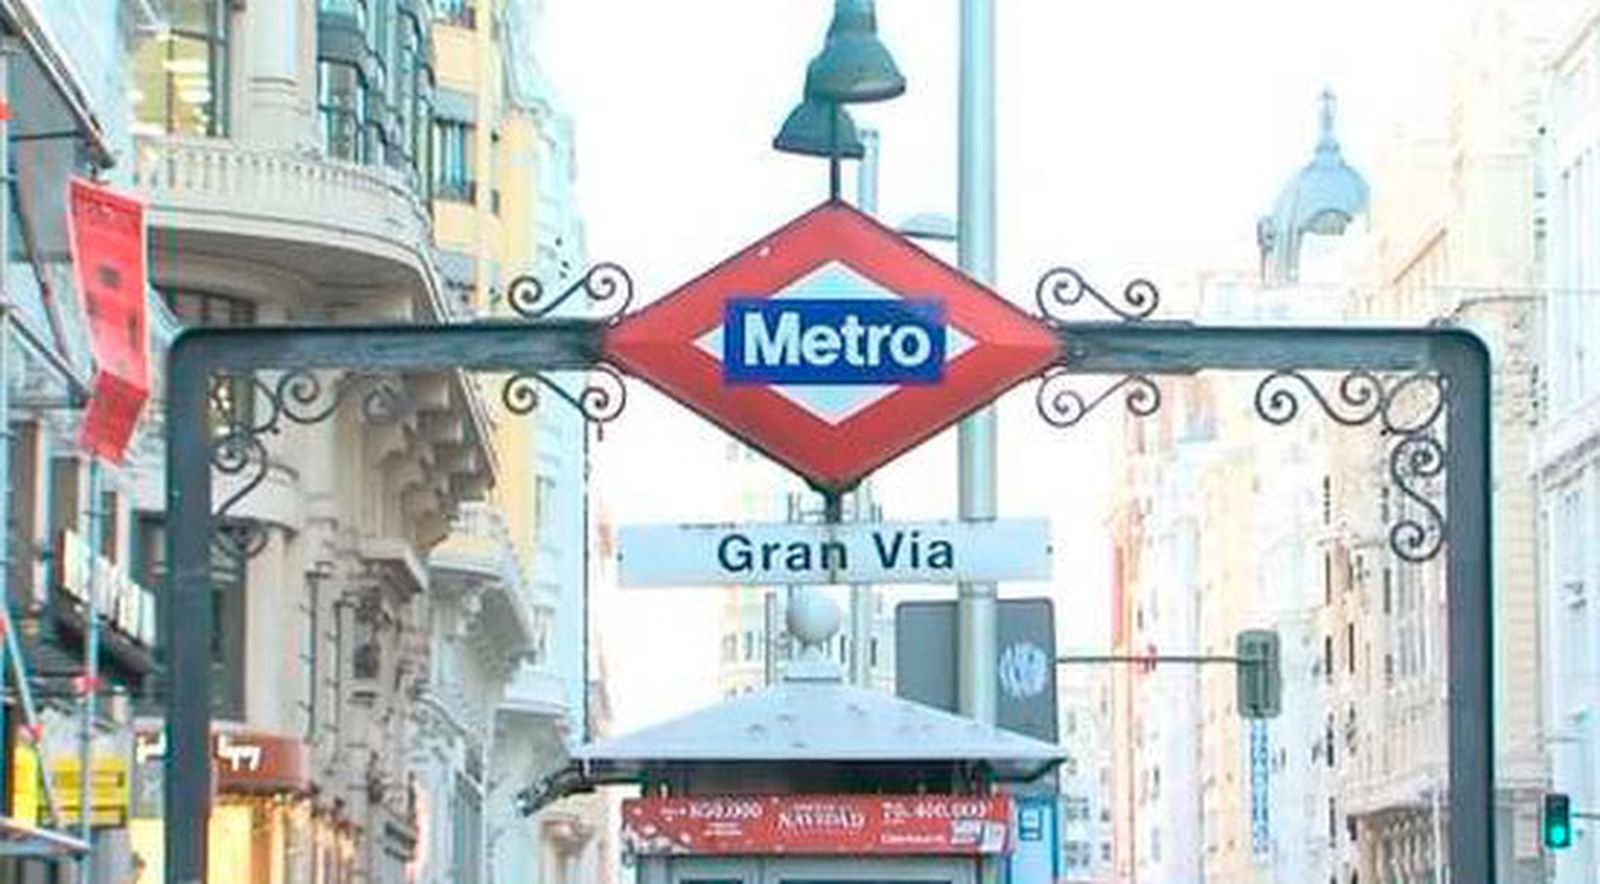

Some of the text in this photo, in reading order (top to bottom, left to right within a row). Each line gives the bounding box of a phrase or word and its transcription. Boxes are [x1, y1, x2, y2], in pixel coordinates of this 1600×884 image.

[743, 311, 931, 367] Metro
[717, 534, 848, 572] Gran
[777, 811, 866, 829] NAVIDAD
